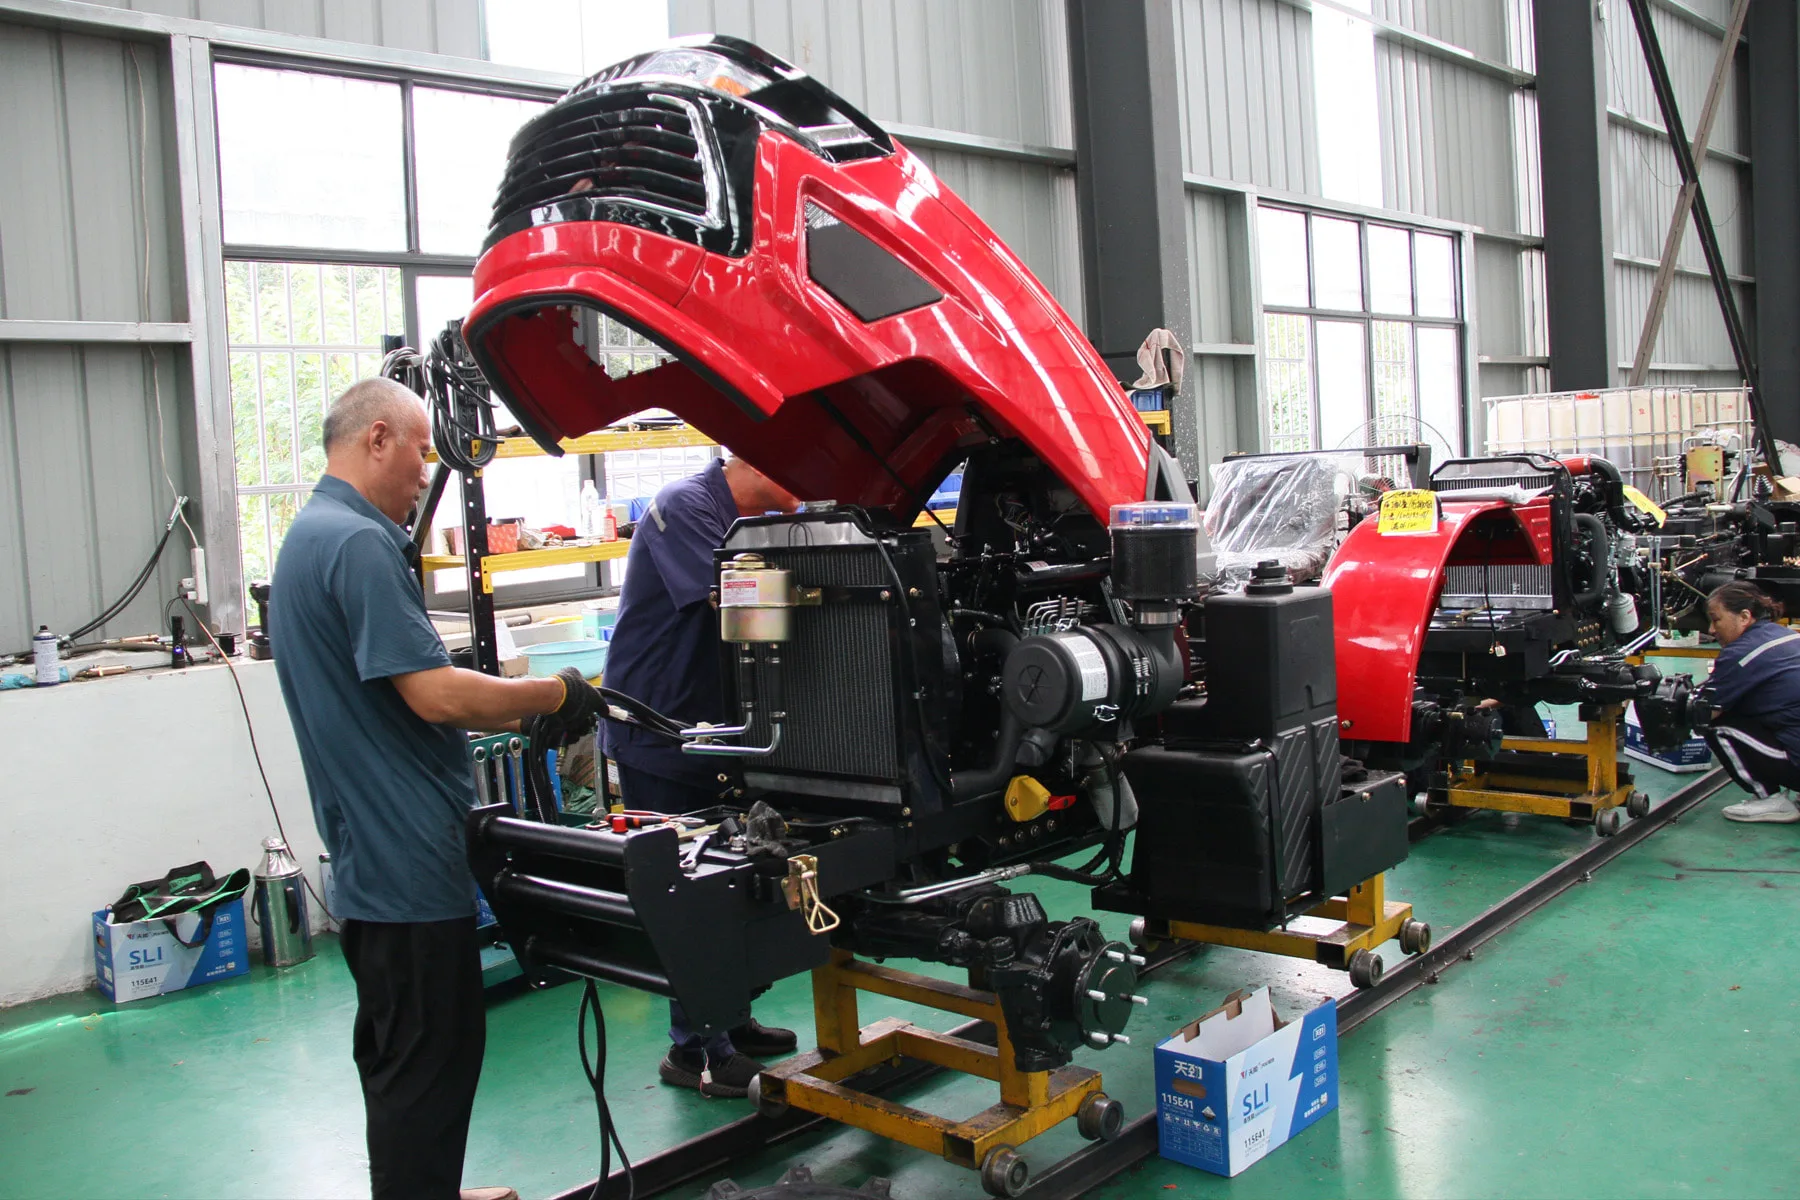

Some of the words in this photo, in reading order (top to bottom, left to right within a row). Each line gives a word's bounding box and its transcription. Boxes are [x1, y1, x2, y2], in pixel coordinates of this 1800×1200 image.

[129, 946, 162, 965] SLI
[131, 977, 157, 987] 115E41
[1174, 1060, 1202, 1080] 天劲
[1161, 1093, 1194, 1110] 115E41
[1242, 1083, 1269, 1116] SLI
[1244, 1129, 1265, 1148] 115E41
